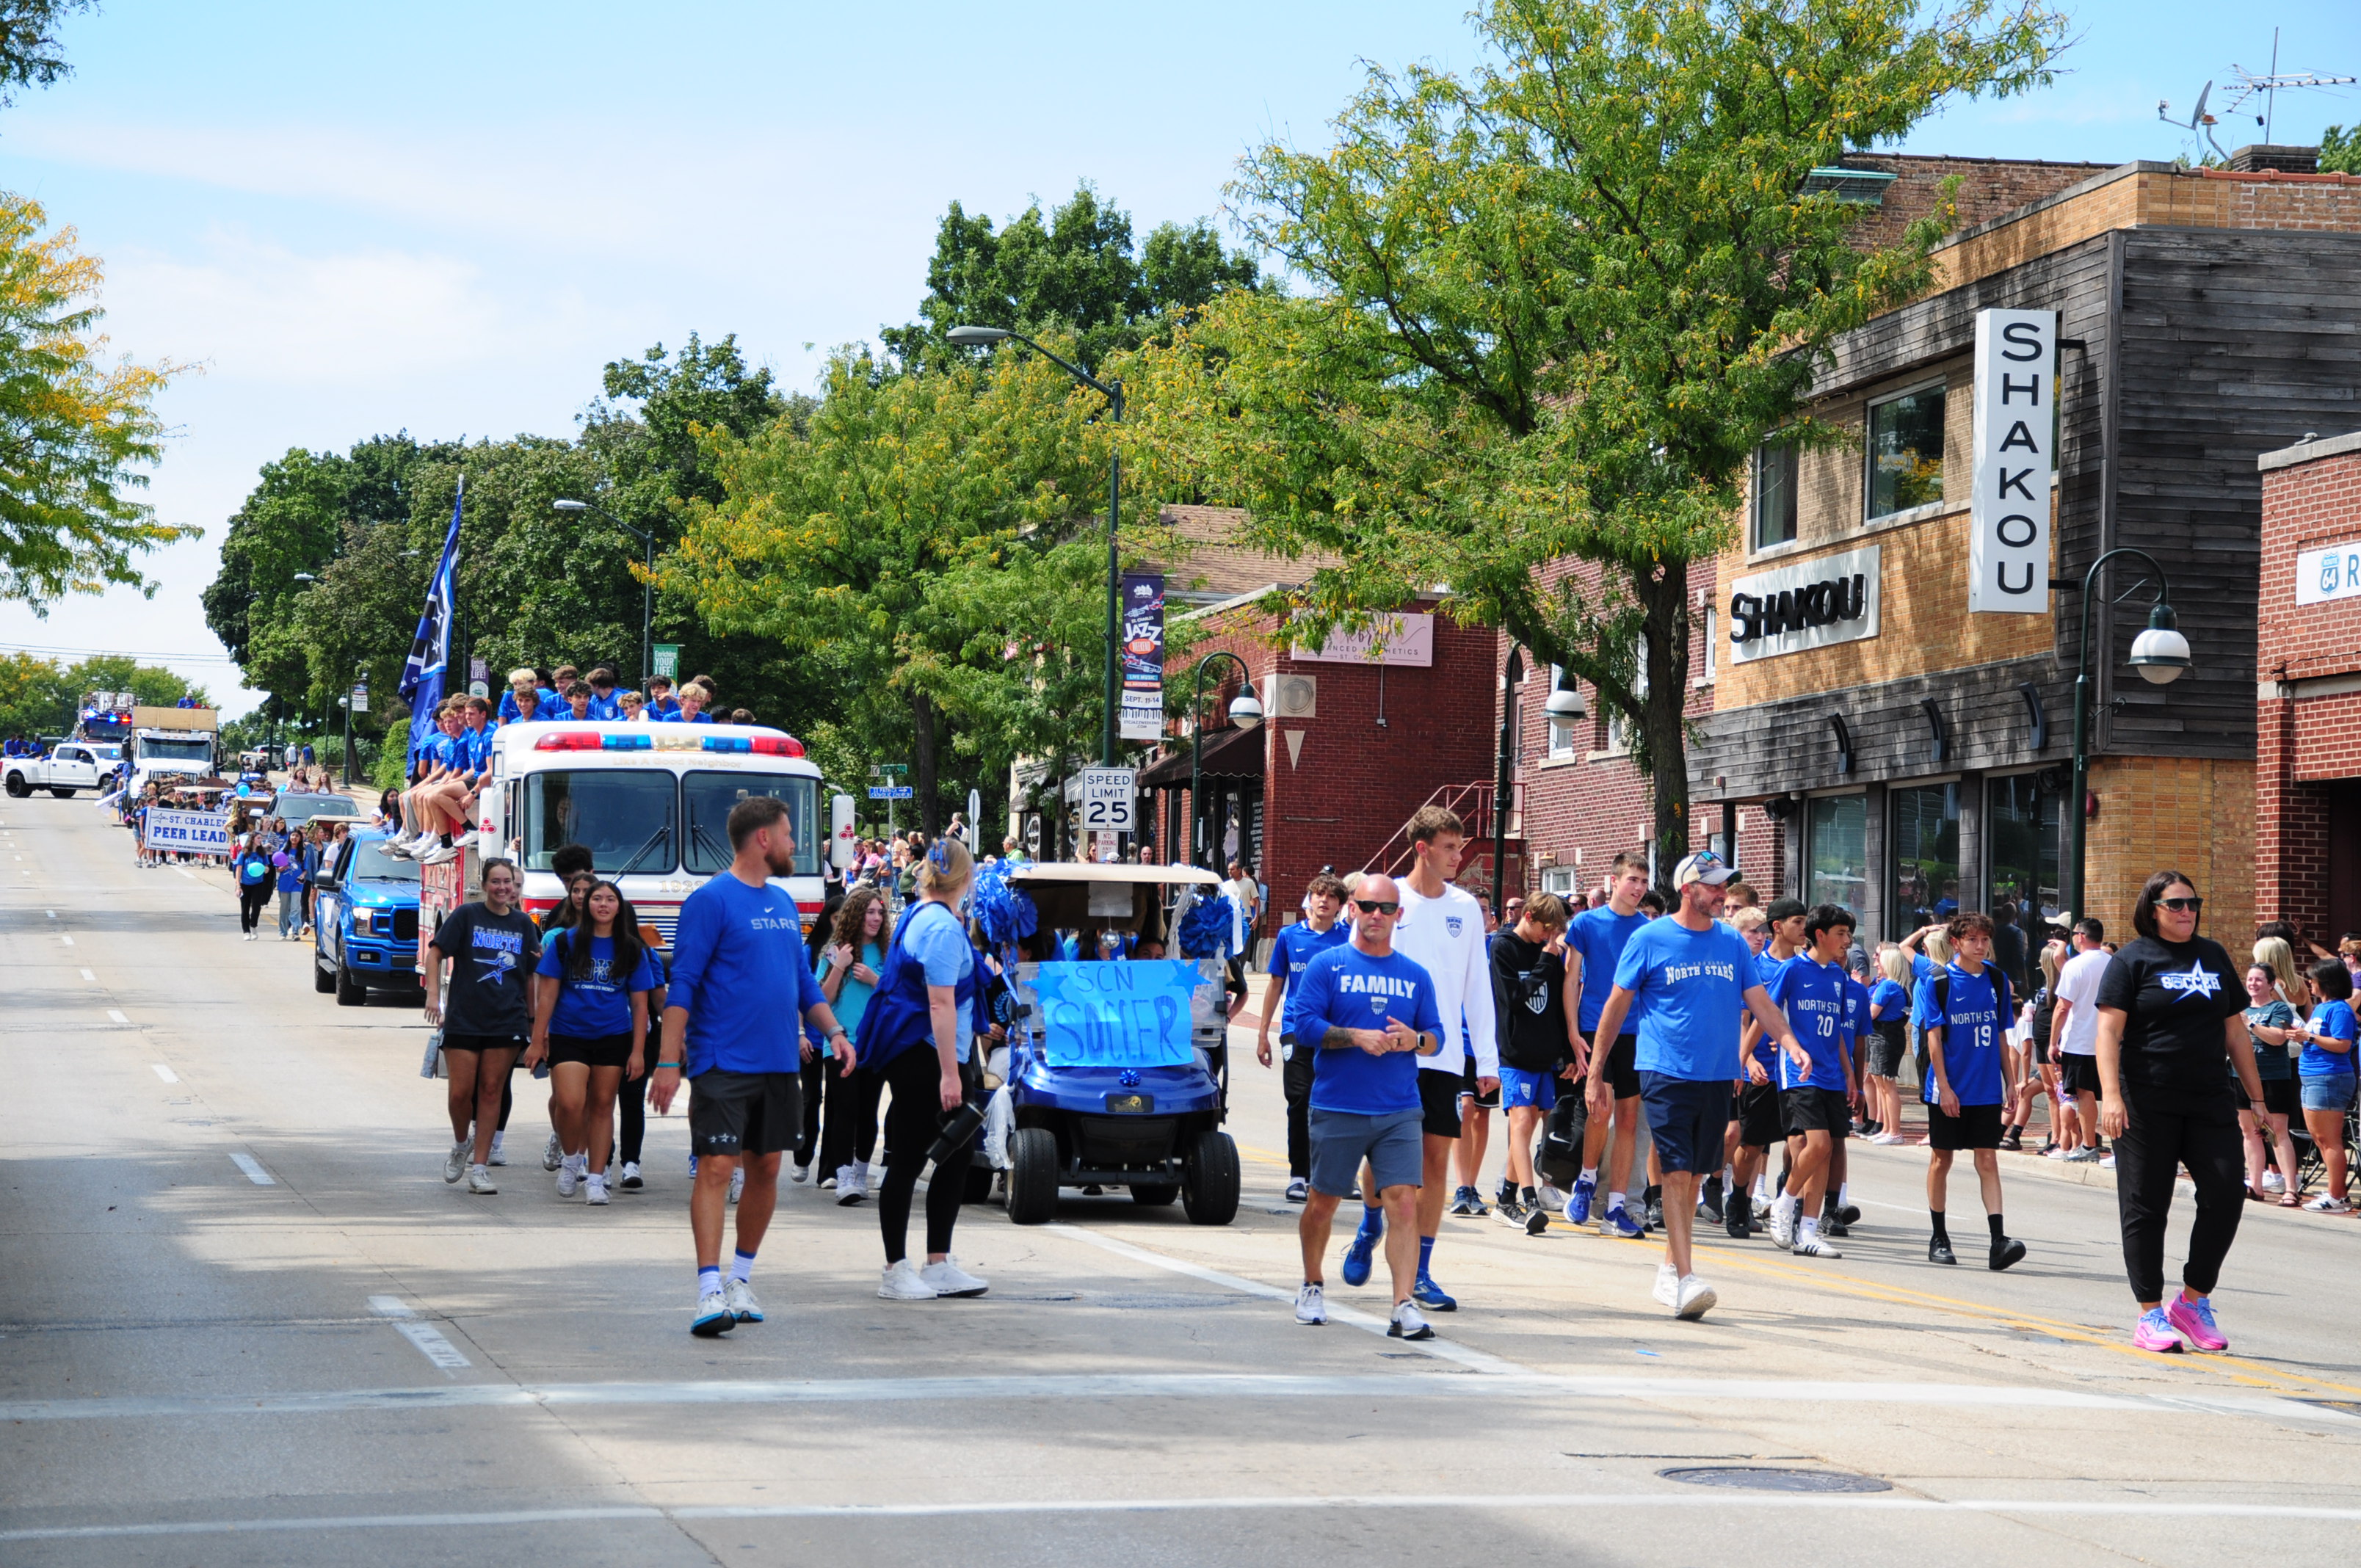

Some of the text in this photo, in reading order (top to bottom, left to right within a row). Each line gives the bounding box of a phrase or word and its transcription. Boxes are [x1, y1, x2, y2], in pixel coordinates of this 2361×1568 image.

[1996, 322, 2043, 595] SHAKOU
[2322, 554, 2360, 589] 64 R
[1730, 573, 1865, 644] SHAKOU
[1123, 622, 1163, 646] JAZZ
[654, 658, 674, 667] YOUR
[654, 666, 674, 676] LIFE!
[471, 671, 486, 679] LIFE!
[1125, 695, 1143, 703] SEPT.
[612, 757, 637, 766] Like
[653, 758, 684, 766] Good
[688, 758, 742, 768] Neighbor
[1087, 775, 1131, 785] SPEED
[1092, 788, 1125, 798] LIMIT
[1088, 801, 1128, 824] 25
[153, 826, 229, 843] PEER LEAD
[751, 918, 798, 931] STARS
[472, 931, 523, 954] NORTH
[1290, 962, 1308, 973] NOR
[1665, 963, 1734, 986] NORTH STARS
[1076, 965, 1134, 992] SCN
[1340, 974, 1416, 999] FAMILY
[2161, 976, 2222, 990] SOCCER
[1798, 999, 1826, 1012] NORTH
[1817, 1015, 1834, 1037] 20
[1951, 1012, 1982, 1025] NORTH
[1051, 995, 1183, 1062] SOCCER
[1974, 1025, 1992, 1047] 19
